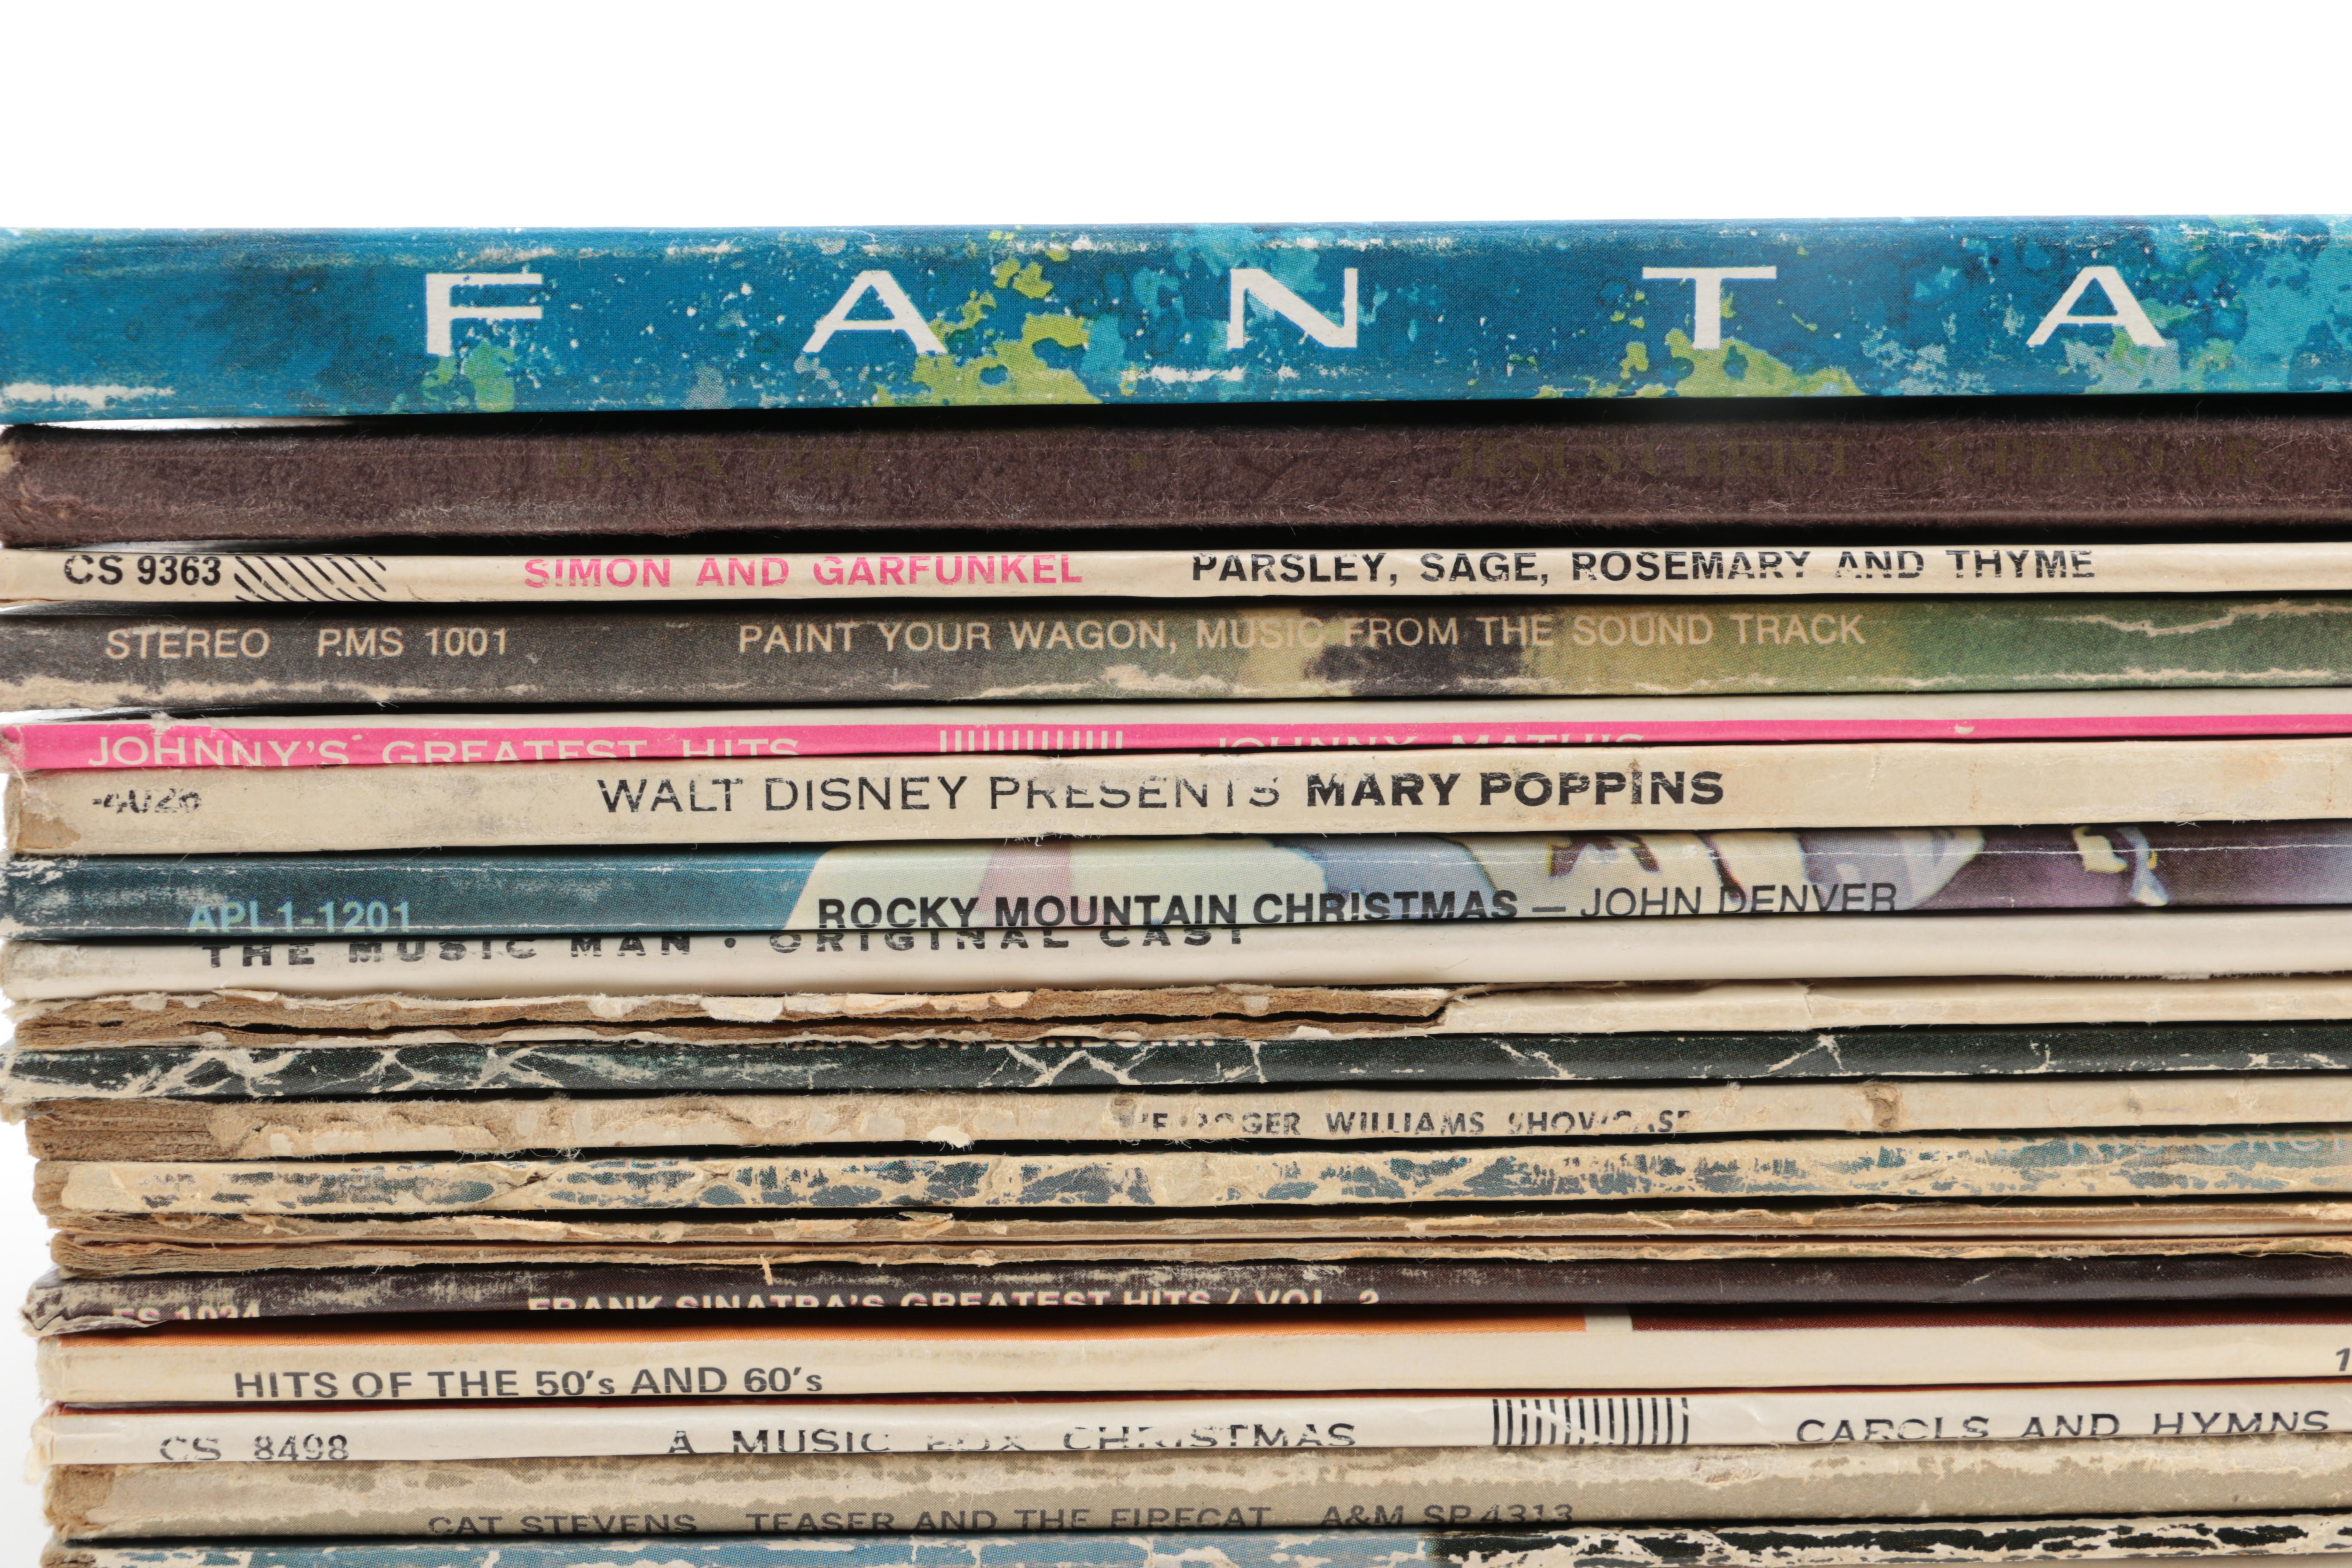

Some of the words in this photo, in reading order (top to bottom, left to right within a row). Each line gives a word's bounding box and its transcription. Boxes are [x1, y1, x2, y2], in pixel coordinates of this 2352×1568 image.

[64, 555, 123, 585] CS
[137, 554, 222, 586] 9363
[524, 558, 671, 588] SIMON
[696, 557, 789, 587] AND
[813, 554, 1083, 585] GARFUNKEL
[1192, 552, 1398, 587] PARSLEY,
[1420, 552, 1548, 586] SAGE,
[1571, 551, 1811, 582] ROSEMARY
[1835, 551, 1924, 579] AND
[1945, 549, 2095, 579] THYME
[105, 628, 271, 660] STEREO
[429, 627, 507, 657] 1001
[738, 623, 860, 654] PAINT
[877, 622, 992, 652] YOUR
[1009, 619, 1177, 655] WAGON,
[1196, 617, 1326, 649] MUSIC
[1344, 617, 1458, 647] FROM
[1475, 616, 1555, 646] THE
[1572, 615, 1714, 646] SOUND
[1730, 613, 1866, 645] TRACK
[88, 736, 349, 767] JOHNNY'S
[597, 778, 744, 813] WALT
[765, 776, 967, 812] DISNEY
[990, 776, 1280, 810] PRESENTS
[1307, 773, 1461, 807] MARY
[1479, 771, 1724, 807] POPPINS
[187, 899, 413, 934] APL1-1201
[818, 896, 978, 929] ROCKY
[995, 893, 1237, 927] MOUNTAIN
[1253, 889, 1518, 923] CHRISTMAS
[1580, 885, 1702, 918] JOHN
[1719, 882, 1898, 913] DENVER
[202, 943, 315, 968] THE
[348, 939, 537, 962] MUSIC
[570, 937, 690, 957] MAN
[769, 929, 1069, 953] ORIGINAL
[1099, 928, 1245, 948] CAST
[235, 1372, 338, 1398] HITS
[352, 1371, 412, 1398] OF
[427, 1370, 519, 1397] THE
[536, 1370, 615, 1396] 50's
[630, 1367, 727, 1394] AND
[743, 1366, 823, 1393] 60's
[2021, 1413, 2121, 1439] AND
[2152, 1410, 2331, 1436] HYMNS
[159, 1436, 222, 1461] CS
[253, 1434, 349, 1461] 8498
[668, 1430, 698, 1453] A
[429, 1516, 503, 1535] CAT
[521, 1513, 698, 1534] STEVENS
[746, 1511, 894, 1532] TEASER
[914, 1510, 998, 1530] AND
[1014, 1508, 1091, 1529] THE
[1321, 1504, 1405, 1526] A&M
